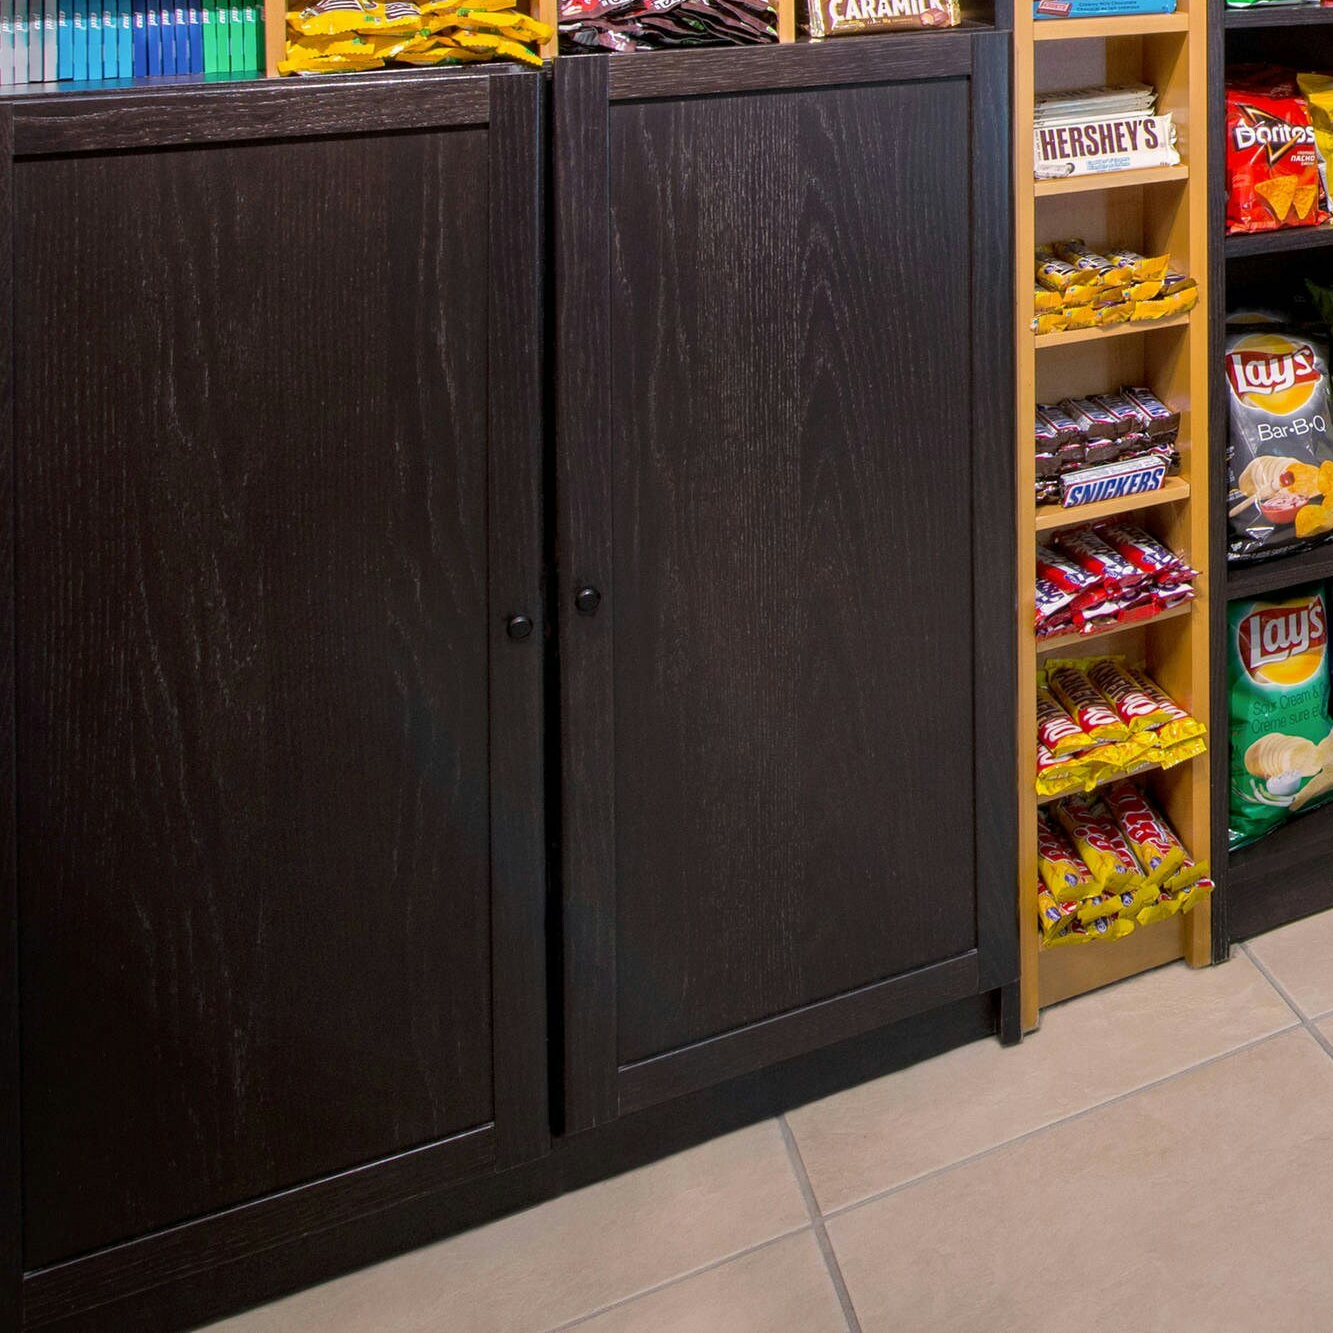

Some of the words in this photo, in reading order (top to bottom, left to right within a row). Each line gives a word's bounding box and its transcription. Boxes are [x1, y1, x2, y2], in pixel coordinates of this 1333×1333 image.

[1039, 117, 1158, 161] HERSHEY'S
[1233, 123, 1315, 151] Doritos
[1065, 466, 1164, 506] SNICKERS
[1249, 603, 1325, 667] Lay's
